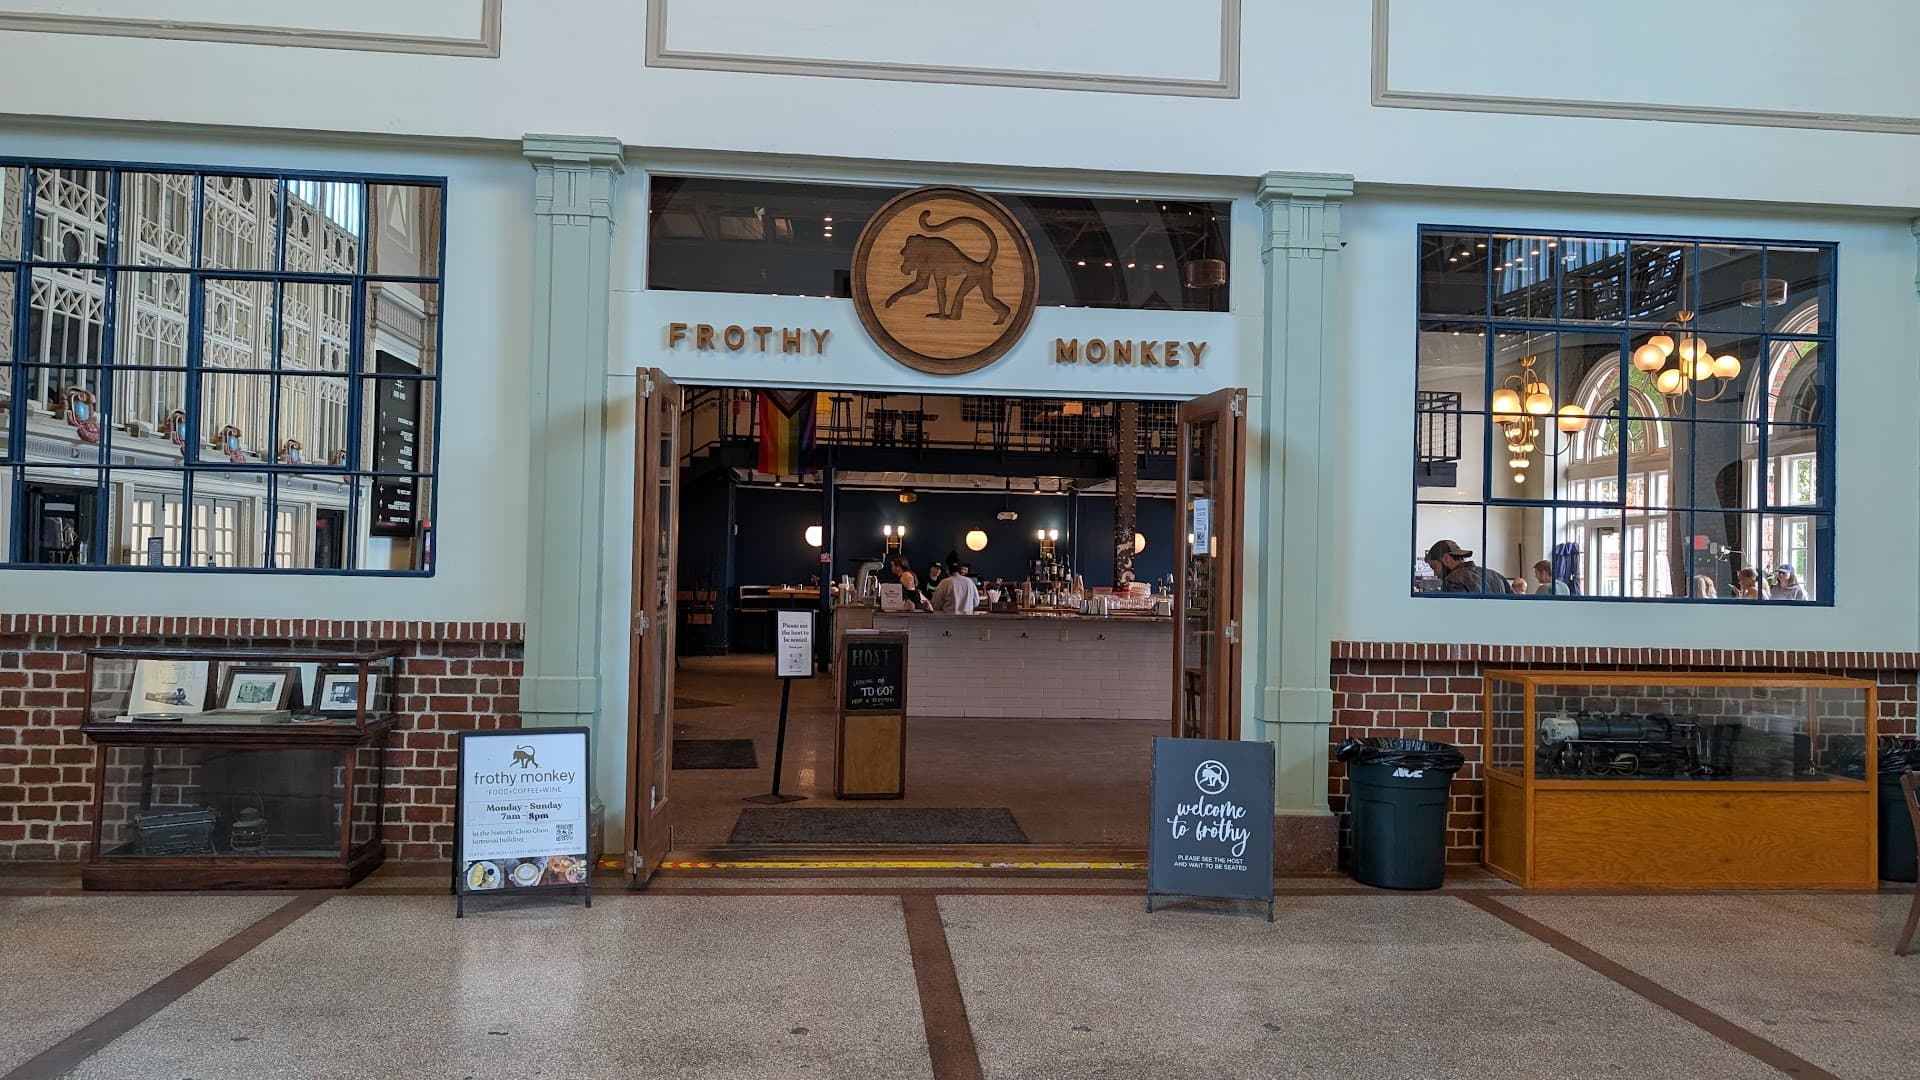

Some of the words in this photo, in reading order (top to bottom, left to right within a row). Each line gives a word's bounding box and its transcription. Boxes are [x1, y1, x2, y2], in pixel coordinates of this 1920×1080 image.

[669, 322, 831, 354] FROTHY
[1055, 337, 1208, 367] MONKEY
[852, 649, 889, 666] HOST
[861, 687, 874, 696] TO
[876, 685, 894, 696] GO?
[474, 770, 517, 786] frothy
[520, 769, 576, 784] monkey
[486, 803, 522, 813] Monday
[530, 801, 563, 810] Sunday
[1176, 796, 1246, 819] welcome
[528, 812, 549, 821] 8pm
[499, 836, 524, 844] building
[1167, 815, 1189, 840] to
[1196, 817, 1251, 857] frothy
[1177, 854, 1201, 862] PLEASE
